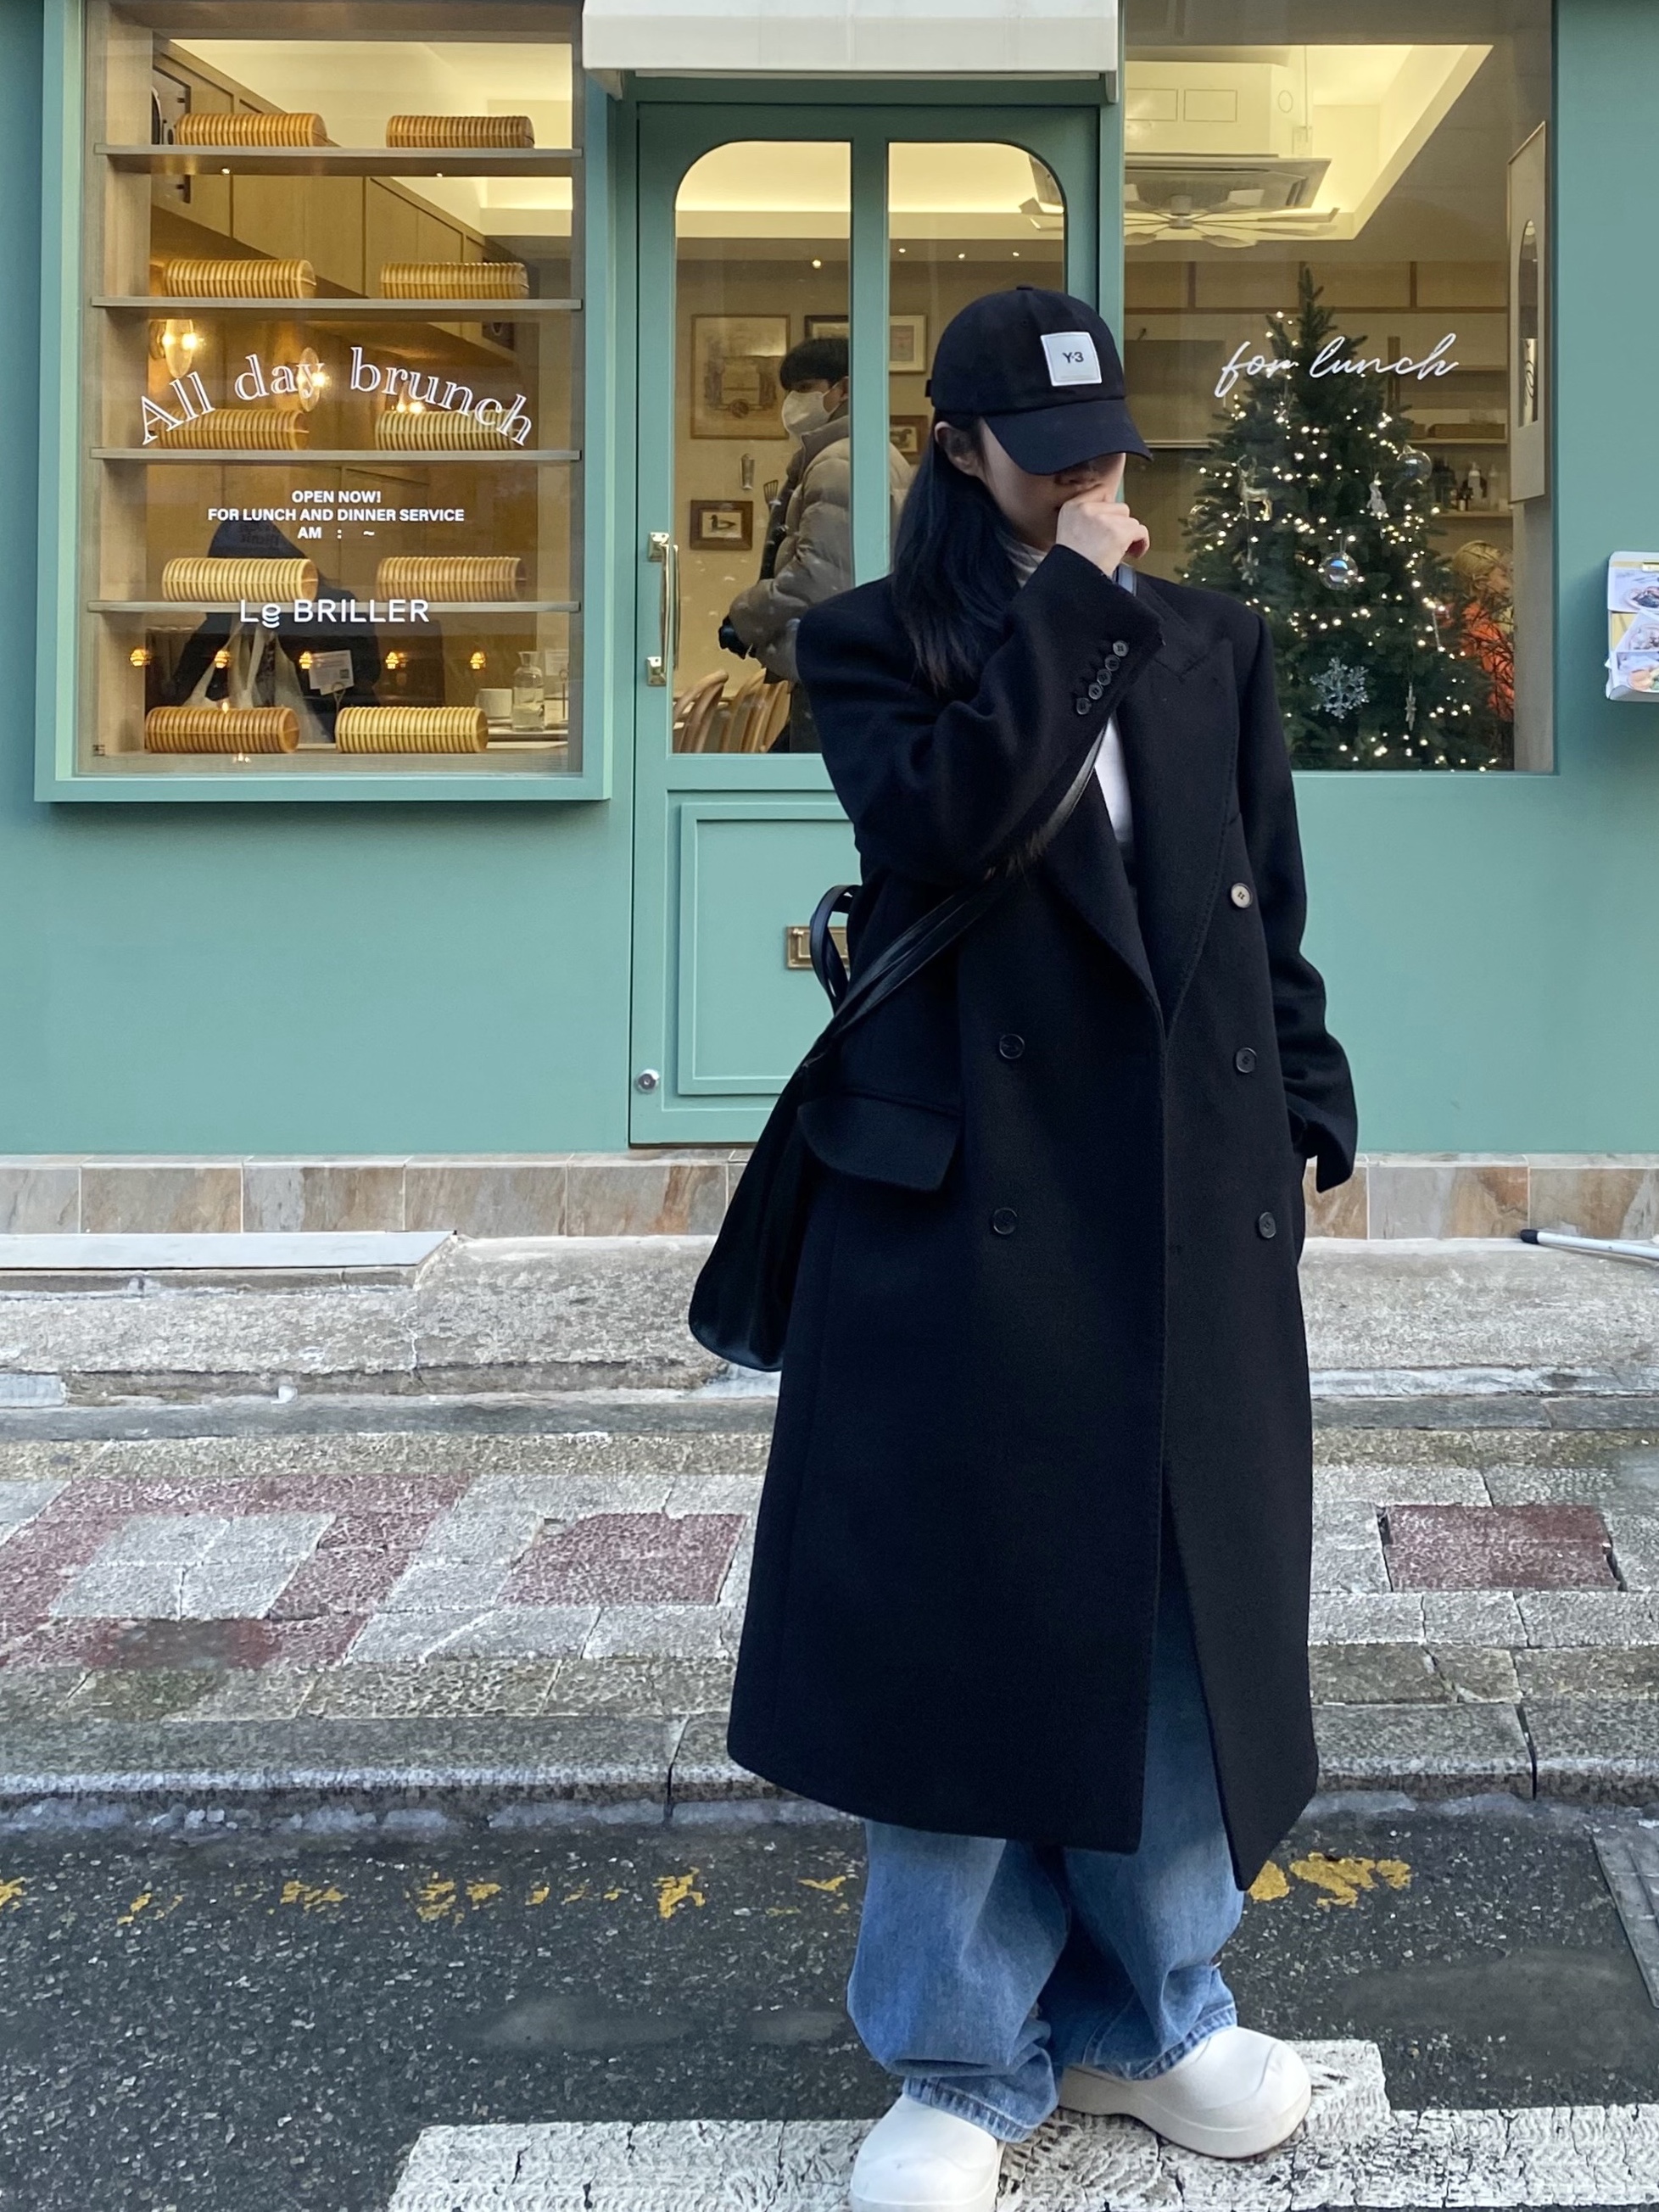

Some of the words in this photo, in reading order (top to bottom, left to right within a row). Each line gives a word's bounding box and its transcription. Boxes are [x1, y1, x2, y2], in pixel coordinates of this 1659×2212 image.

[1214, 340, 1299, 399] for
[1309, 332, 1460, 381] lunch
[139, 371, 216, 445] All
[233, 353, 326, 400] day
[349, 346, 533, 446] brunch
[291, 489, 334, 504] OPEN
[338, 489, 382, 504] NOW!
[207, 507, 239, 522] FOR
[242, 507, 297, 522] LUNCH
[299, 507, 334, 522] AND
[336, 507, 396, 522] DINNER
[398, 507, 466, 522] SERVICE
[296, 526, 323, 539] AM
[239, 599, 282, 628] Le
[293, 598, 430, 623] BRILLER
